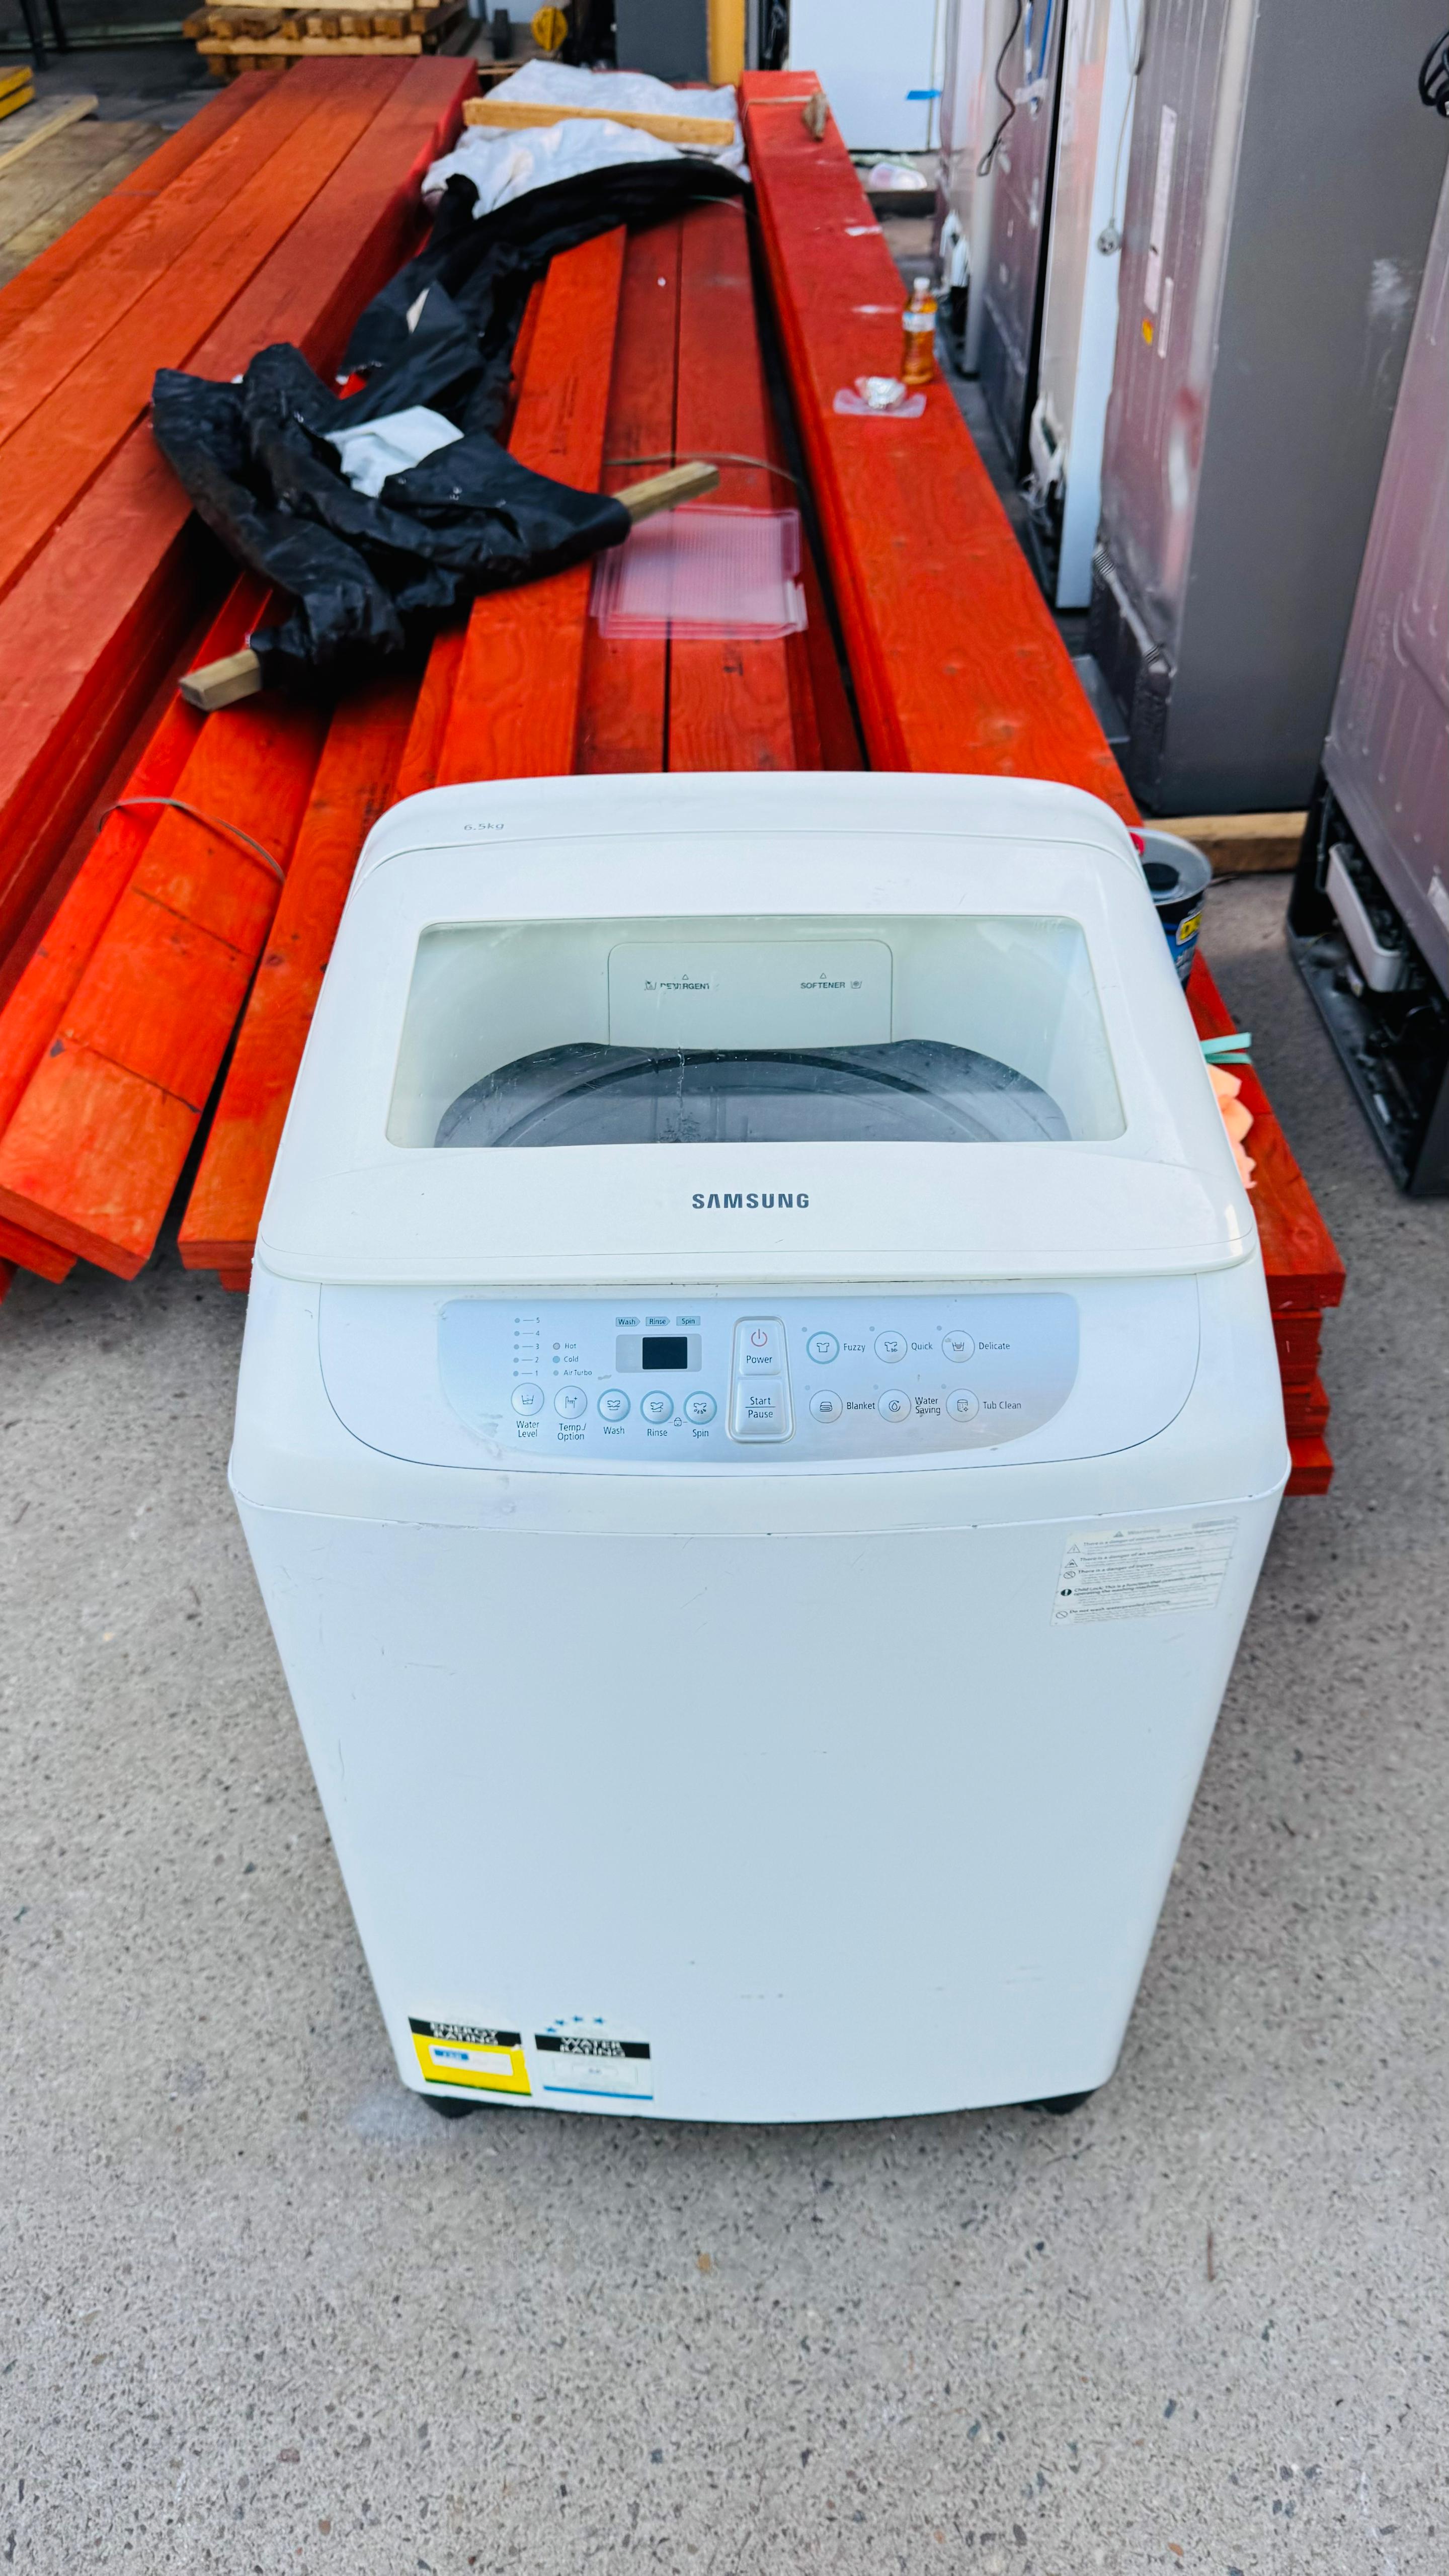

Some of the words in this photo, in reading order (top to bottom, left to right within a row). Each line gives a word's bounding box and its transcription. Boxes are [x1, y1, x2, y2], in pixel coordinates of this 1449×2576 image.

[692, 1193, 809, 1209] SAMSUNG
[682, 1318, 695, 1326] Spin
[843, 1343, 865, 1353] Fuzzy
[911, 1342, 933, 1351] Quick
[979, 1342, 1010, 1350] Delicate
[746, 1355, 772, 1363] Power
[750, 1396, 771, 1405] Start
[915, 1397, 938, 1405] Water
[983, 1401, 997, 1409] Tub
[999, 1401, 1021, 1409] Clean
[847, 1401, 875, 1410] Blanket
[748, 1409, 773, 1418] Pause
[915, 1405, 940, 1416] Saving
[516, 1420, 539, 1428] Water
[559, 1423, 587, 1432] Temp./
[518, 1429, 537, 1437] Level
[603, 1426, 625, 1434] Wash
[647, 1428, 668, 1436] Rinse
[692, 1429, 709, 1439] Spin
[557, 1432, 585, 1442] Option
